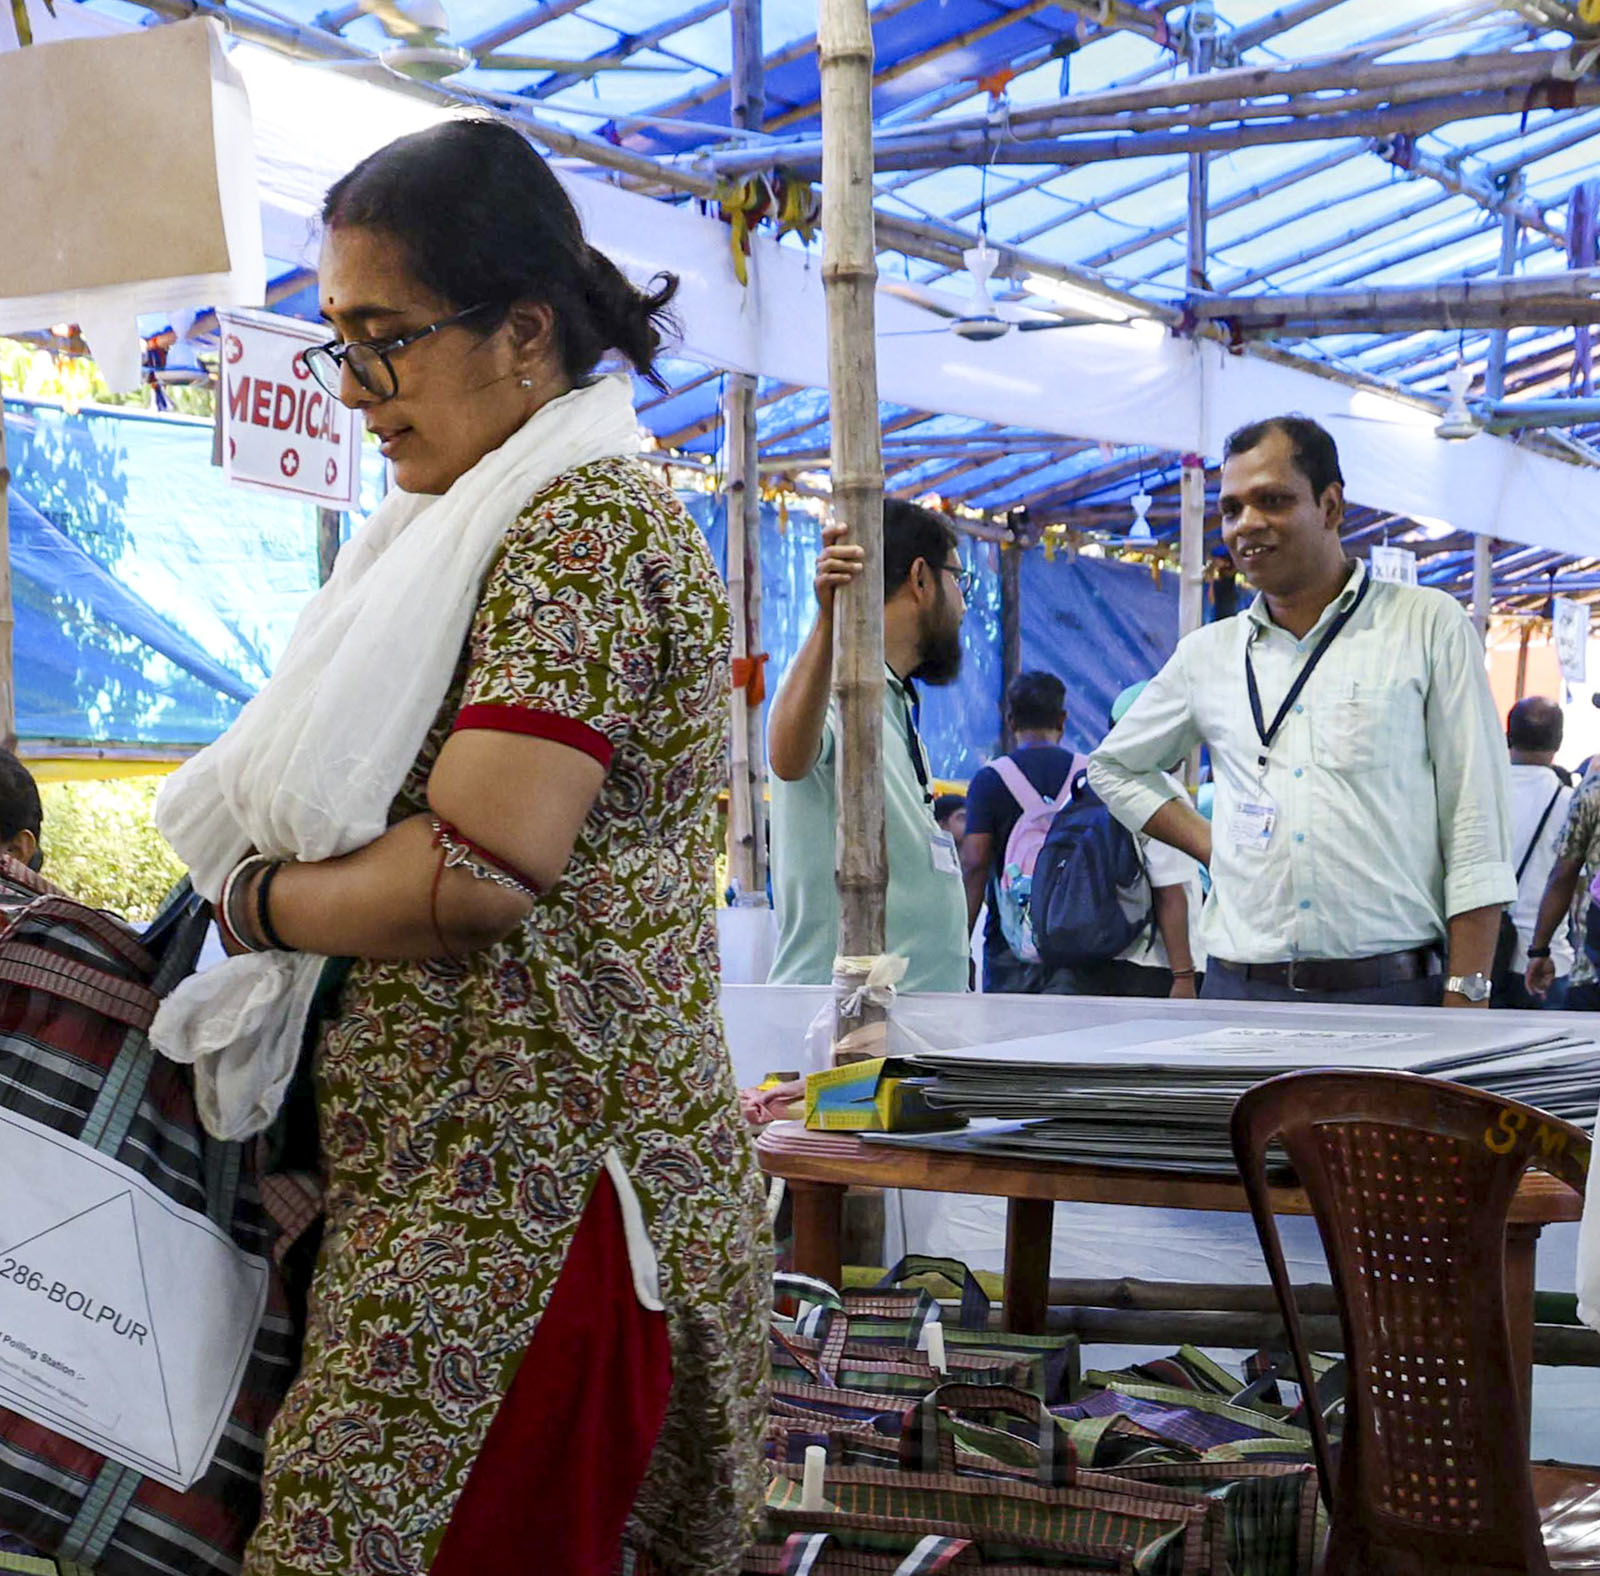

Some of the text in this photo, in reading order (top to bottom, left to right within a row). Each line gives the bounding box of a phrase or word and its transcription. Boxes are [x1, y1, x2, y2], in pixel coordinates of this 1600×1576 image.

[228, 373, 340, 444] MEDICAL
[2, 1335, 38, 1360] Polling
[39, 1353, 76, 1377] Station
